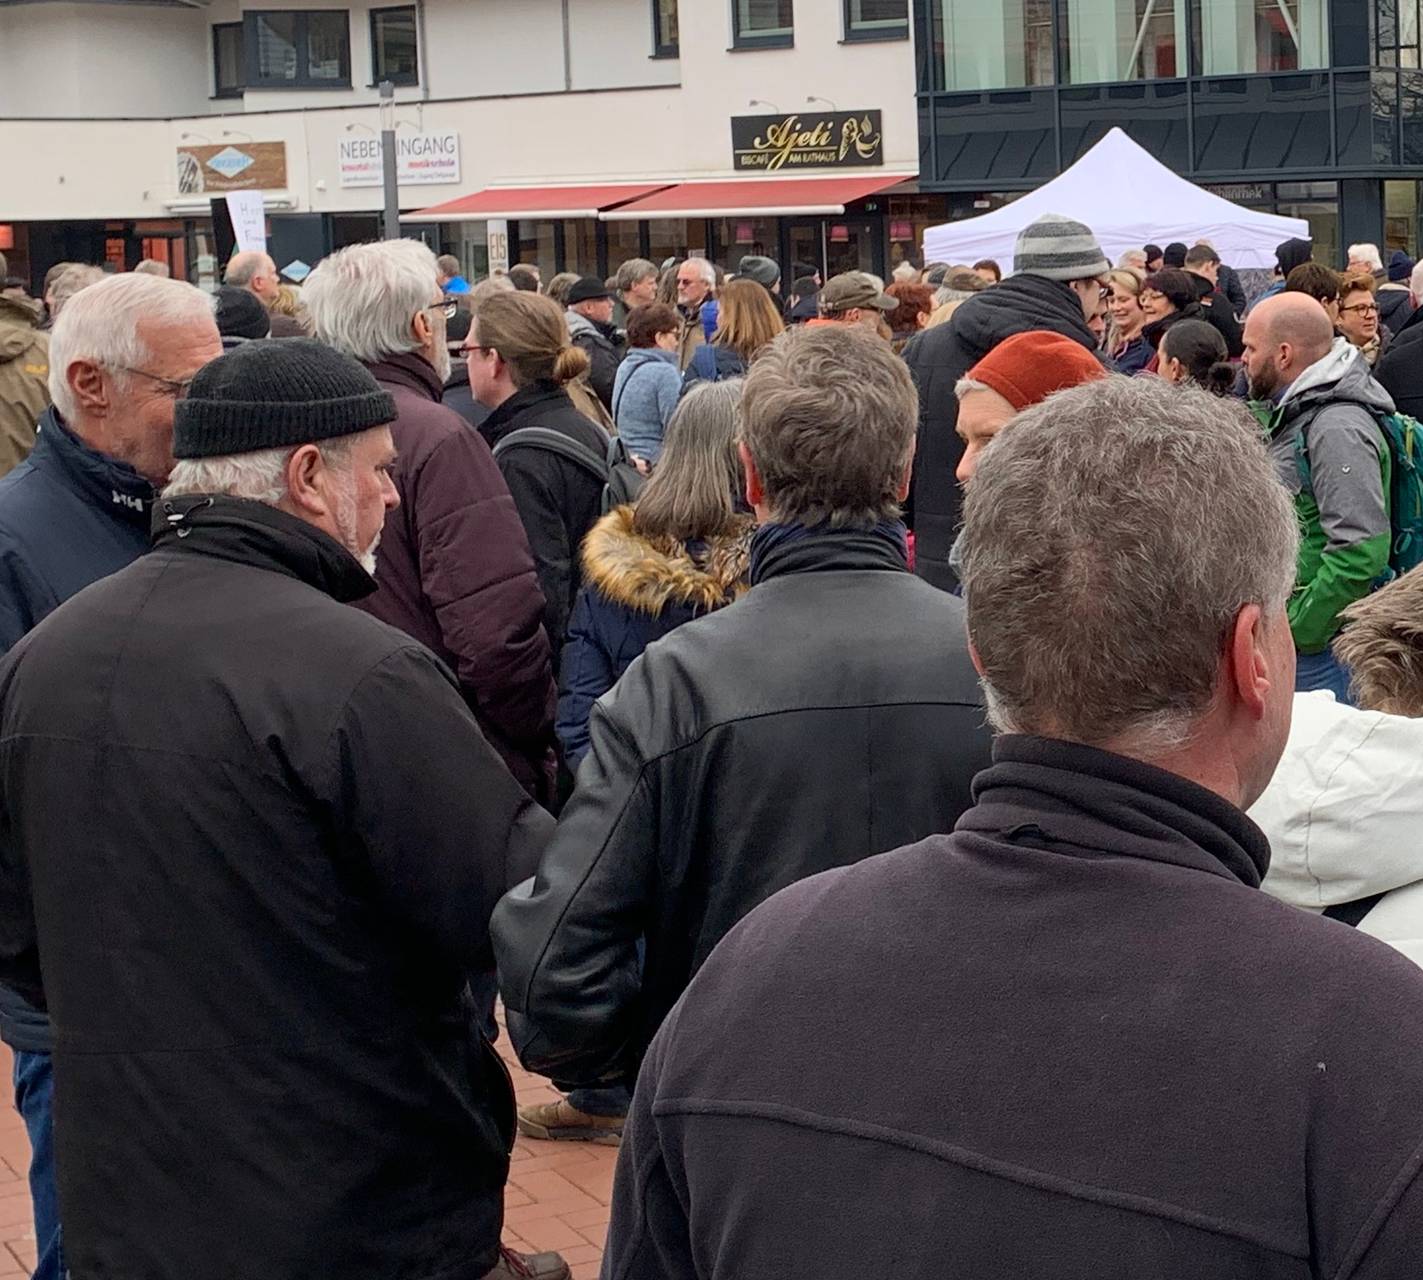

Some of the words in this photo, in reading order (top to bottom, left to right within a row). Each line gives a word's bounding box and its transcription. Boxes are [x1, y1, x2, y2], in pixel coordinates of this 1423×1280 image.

[340, 136, 455, 158] NEBENINGANG
[754, 115, 834, 170] Ajeti
[490, 233, 507, 260] EIS
